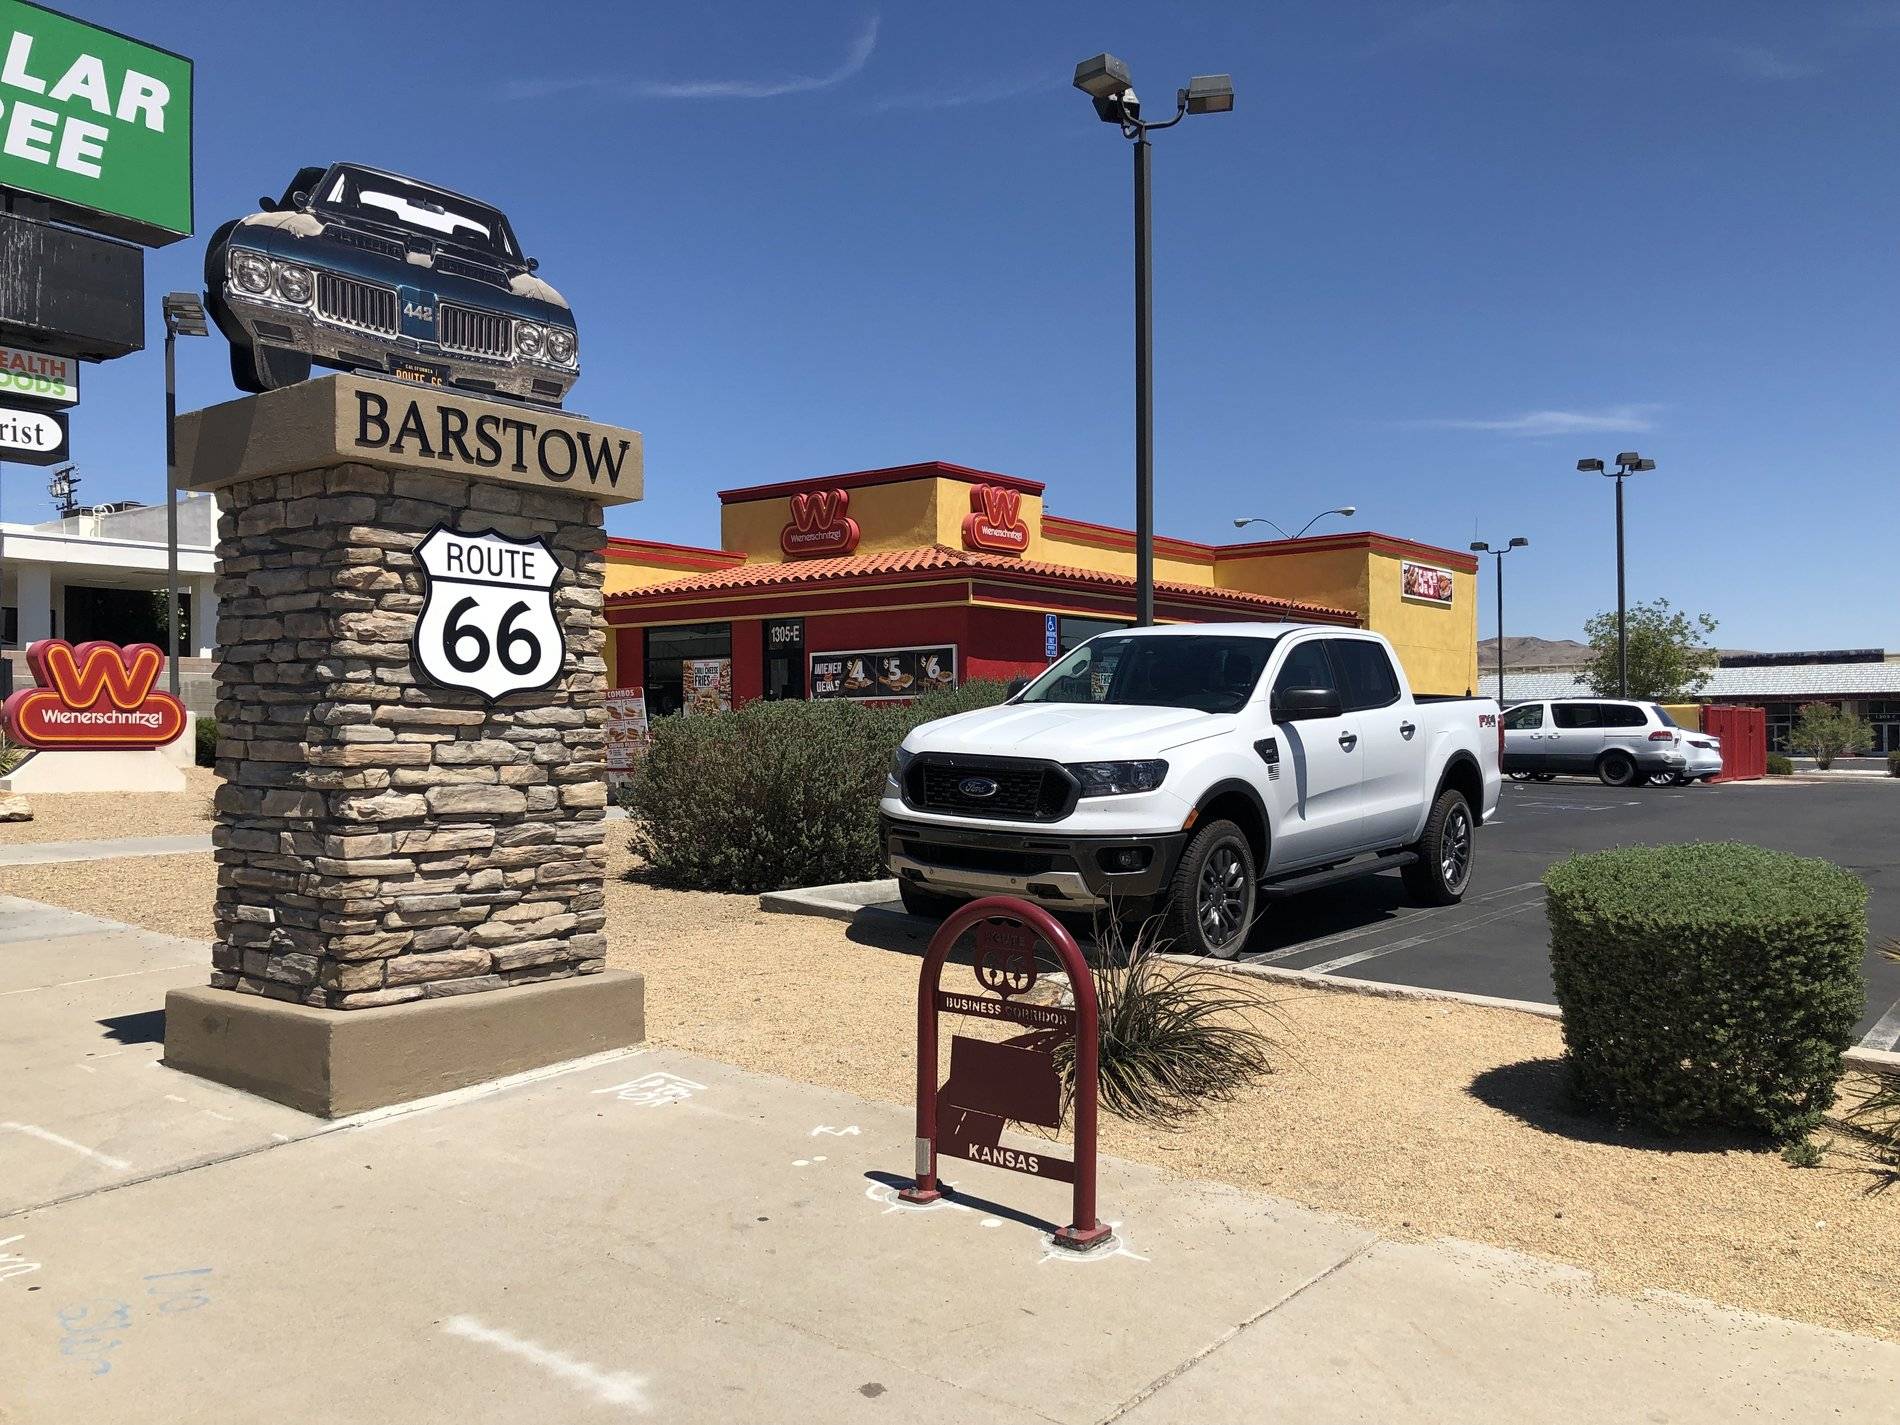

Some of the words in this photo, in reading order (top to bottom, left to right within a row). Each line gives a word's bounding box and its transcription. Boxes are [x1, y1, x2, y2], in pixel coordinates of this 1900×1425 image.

[1, 31, 170, 133] LAR
[0, 100, 109, 179] EE
[403, 301, 433, 322] 442
[354, 389, 631, 488] BARSTOW
[790, 529, 841, 544] Wienerschnitzel
[981, 525, 1023, 543] Wienerschnitzel
[447, 542, 536, 580] ROUTE
[442, 596, 542, 676] 66
[771, 625, 800, 643] 1305-E
[814, 661, 842, 675] WIENER
[694, 674, 711, 687] FRIES
[816, 680, 841, 693] DEALS
[607, 689, 635, 699] COMBOS
[42, 708, 163, 729] Wienerschnitzel
[1478, 714, 1496, 728] FX4
[945, 996, 1002, 1015] BUSINESS
[1004, 1005, 1067, 1025] CORRIDOR
[968, 1142, 1039, 1173] KANSAS
